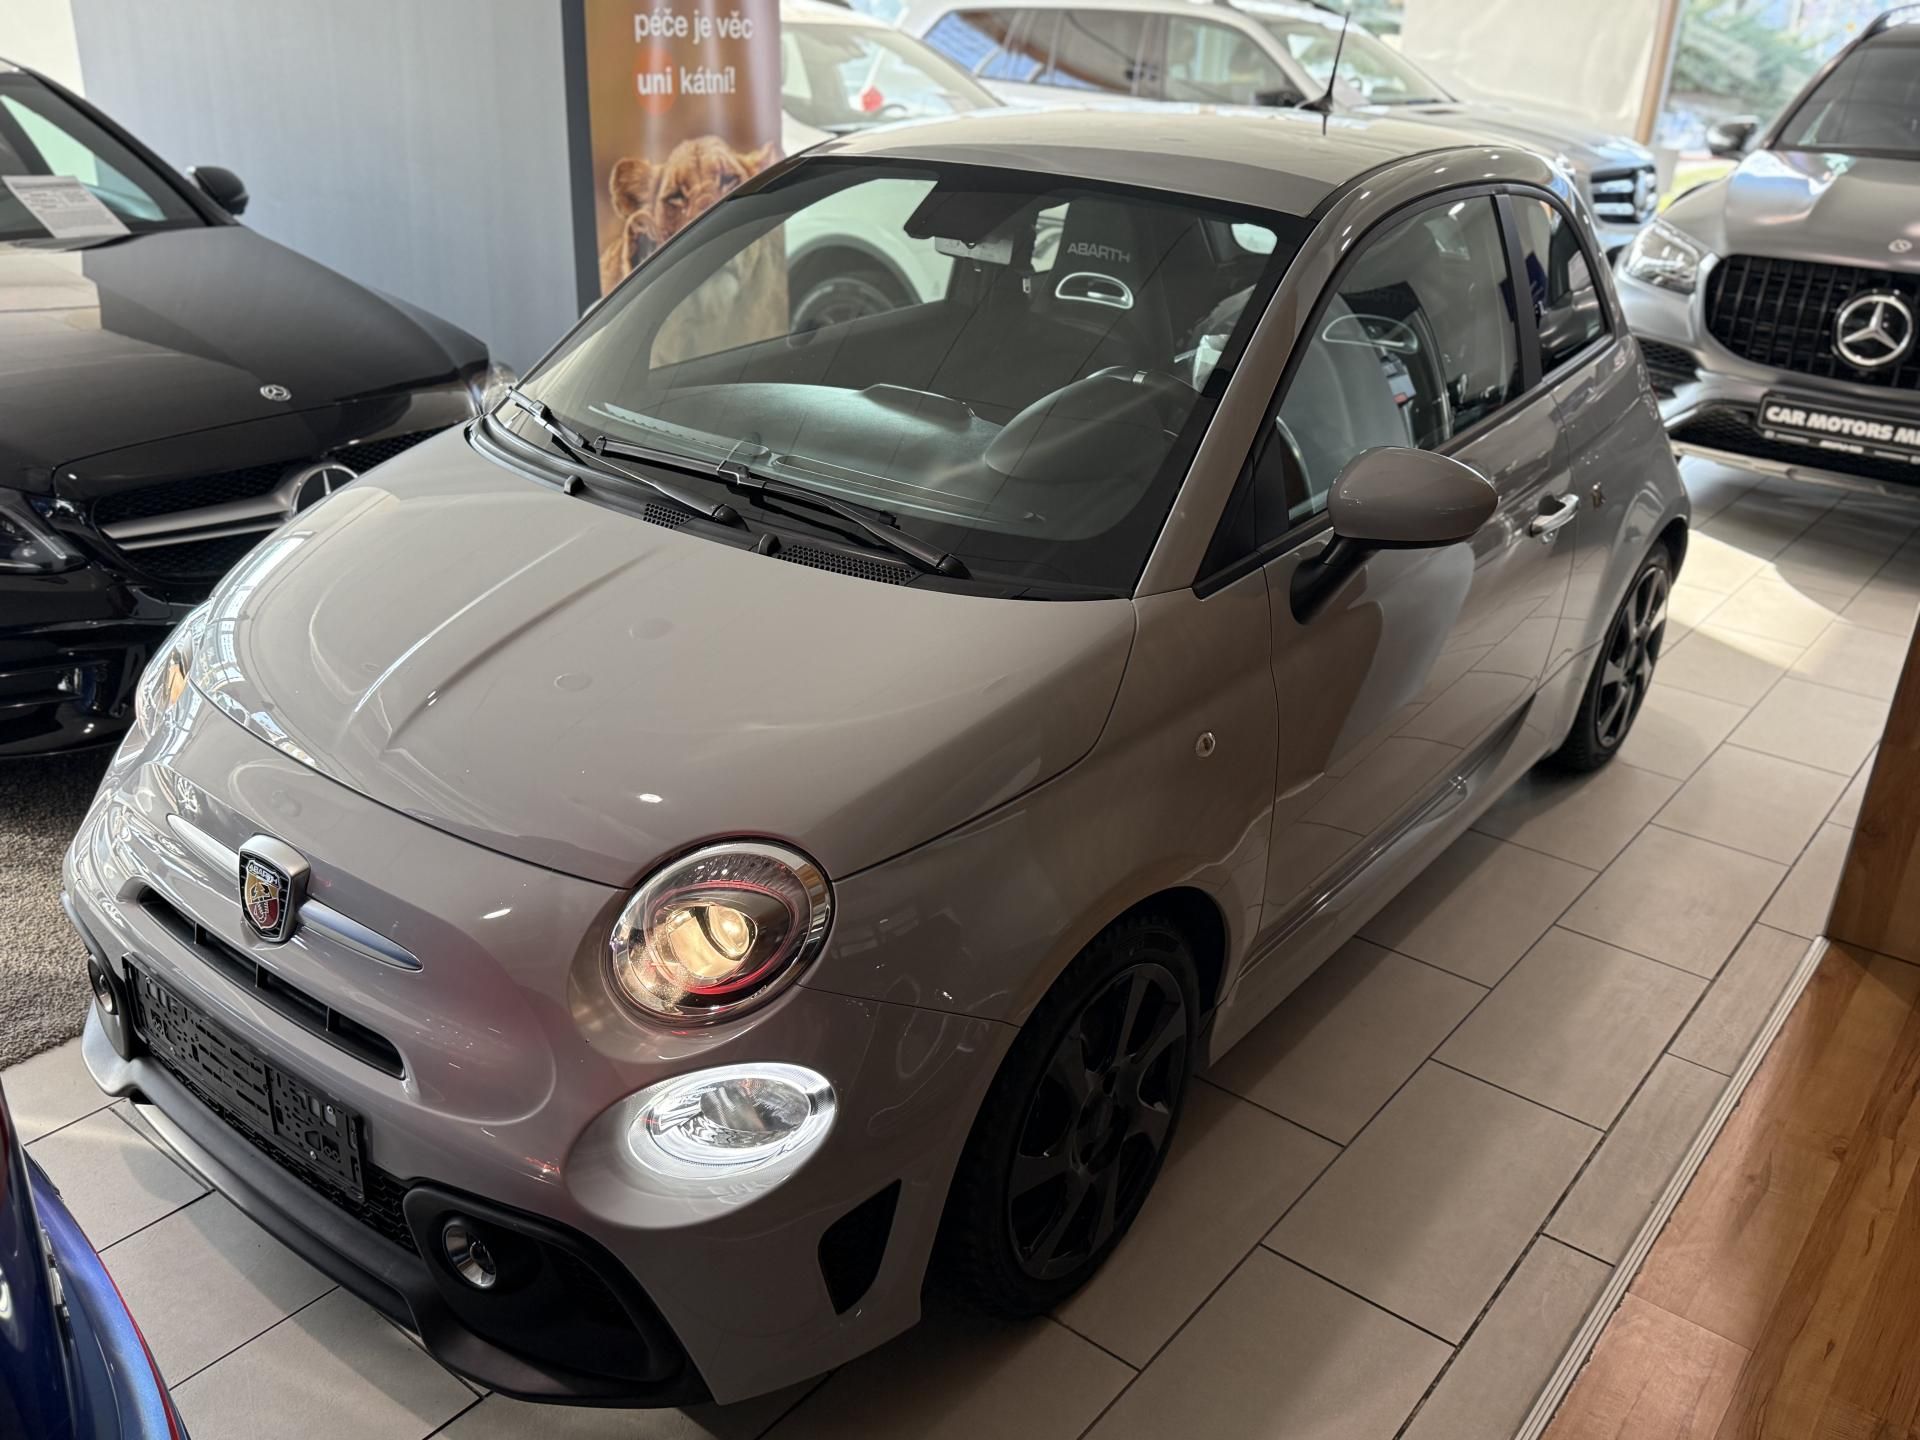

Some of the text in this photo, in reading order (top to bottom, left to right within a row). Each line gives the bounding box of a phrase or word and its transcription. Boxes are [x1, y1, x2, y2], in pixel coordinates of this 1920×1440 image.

[634, 8, 753, 45] péče je věc
[637, 65, 736, 95] uni kátní!
[1067, 242, 1130, 263] ABARTH
[1766, 406, 1806, 427] CAR
[1806, 412, 1894, 441] MOTORS
